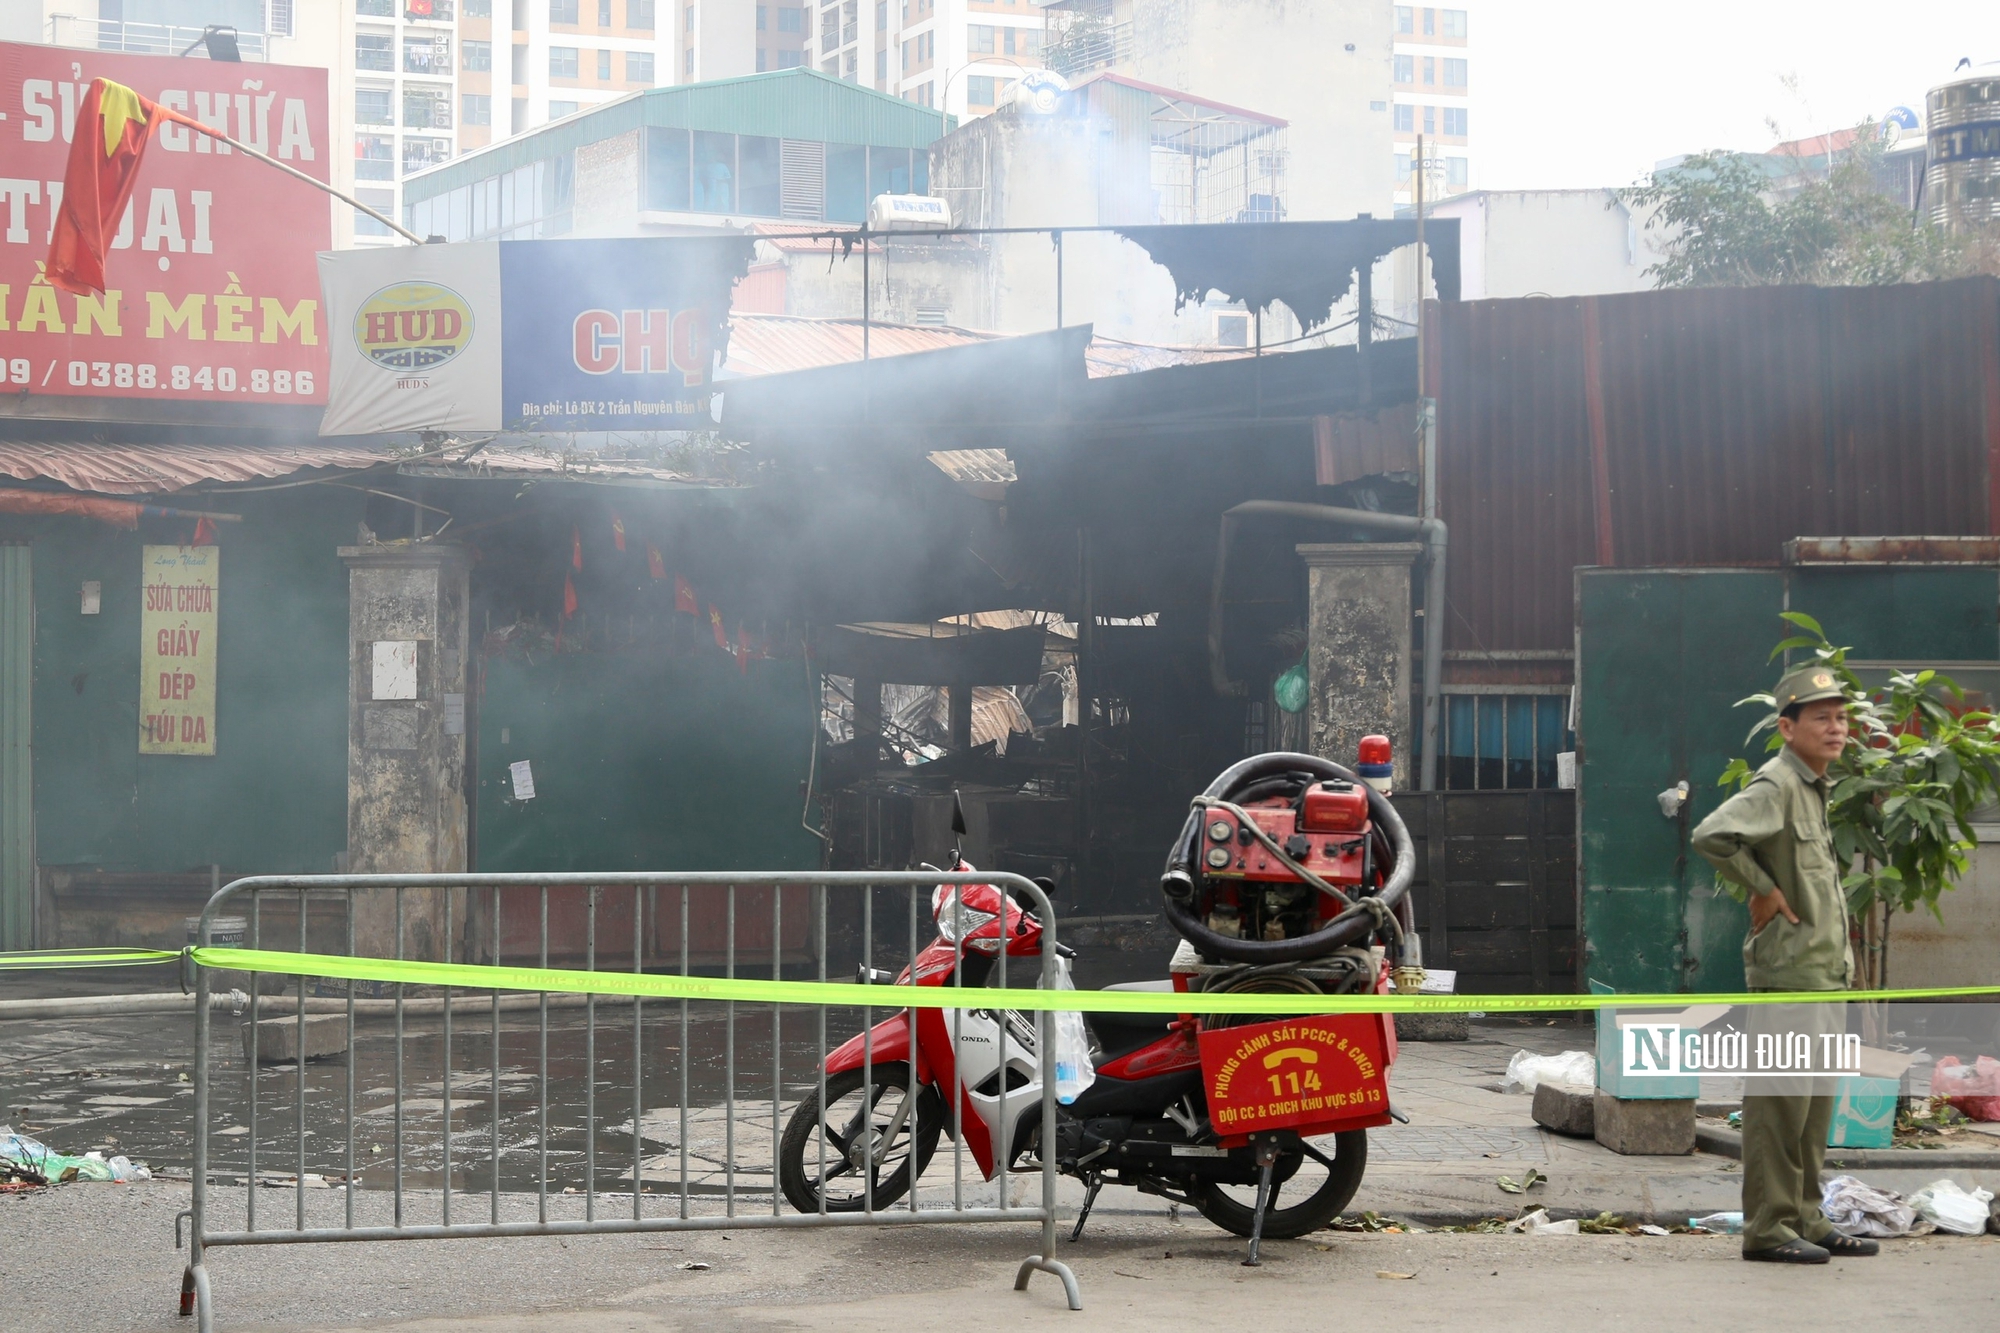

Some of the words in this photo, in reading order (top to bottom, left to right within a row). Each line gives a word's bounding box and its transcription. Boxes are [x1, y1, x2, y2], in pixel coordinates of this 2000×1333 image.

[158, 79, 315, 161] CHỮA
[145, 271, 318, 346] MỀM
[364, 308, 462, 344] HUD
[68, 361, 315, 395] 0388.840.886
[565, 401, 578, 415] Lô
[598, 402, 605, 415] 2
[608, 398, 631, 415] Trần
[634, 400, 673, 416] Nguyên
[147, 573, 173, 612] SỬA
[177, 578, 212, 613] CHỮA
[157, 620, 200, 657] GIẦY
[159, 667, 196, 700] DÉP
[147, 709, 175, 743] TÚI
[181, 715, 207, 743] DA
[1215, 1057, 1240, 1098] PHÒNG
[1236, 1033, 1271, 1060] CẢNH
[1272, 1026, 1297, 1042] SÁT
[1301, 1027, 1337, 1045] PCCC
[1337, 1038, 1348, 1051] &
[1348, 1046, 1376, 1080] CNCH
[1267, 1069, 1322, 1097] 114
[1218, 1106, 1238, 1124] ĐỘI
[1240, 1107, 1256, 1120] CC
[1258, 1105, 1266, 1118] &
[1269, 1100, 1299, 1116] CNCH
[1302, 1097, 1323, 1111] KHU
[1326, 1093, 1347, 1110] VỰC
[1349, 1087, 1364, 1104] SỐ
[1367, 1089, 1380, 1102] 13
